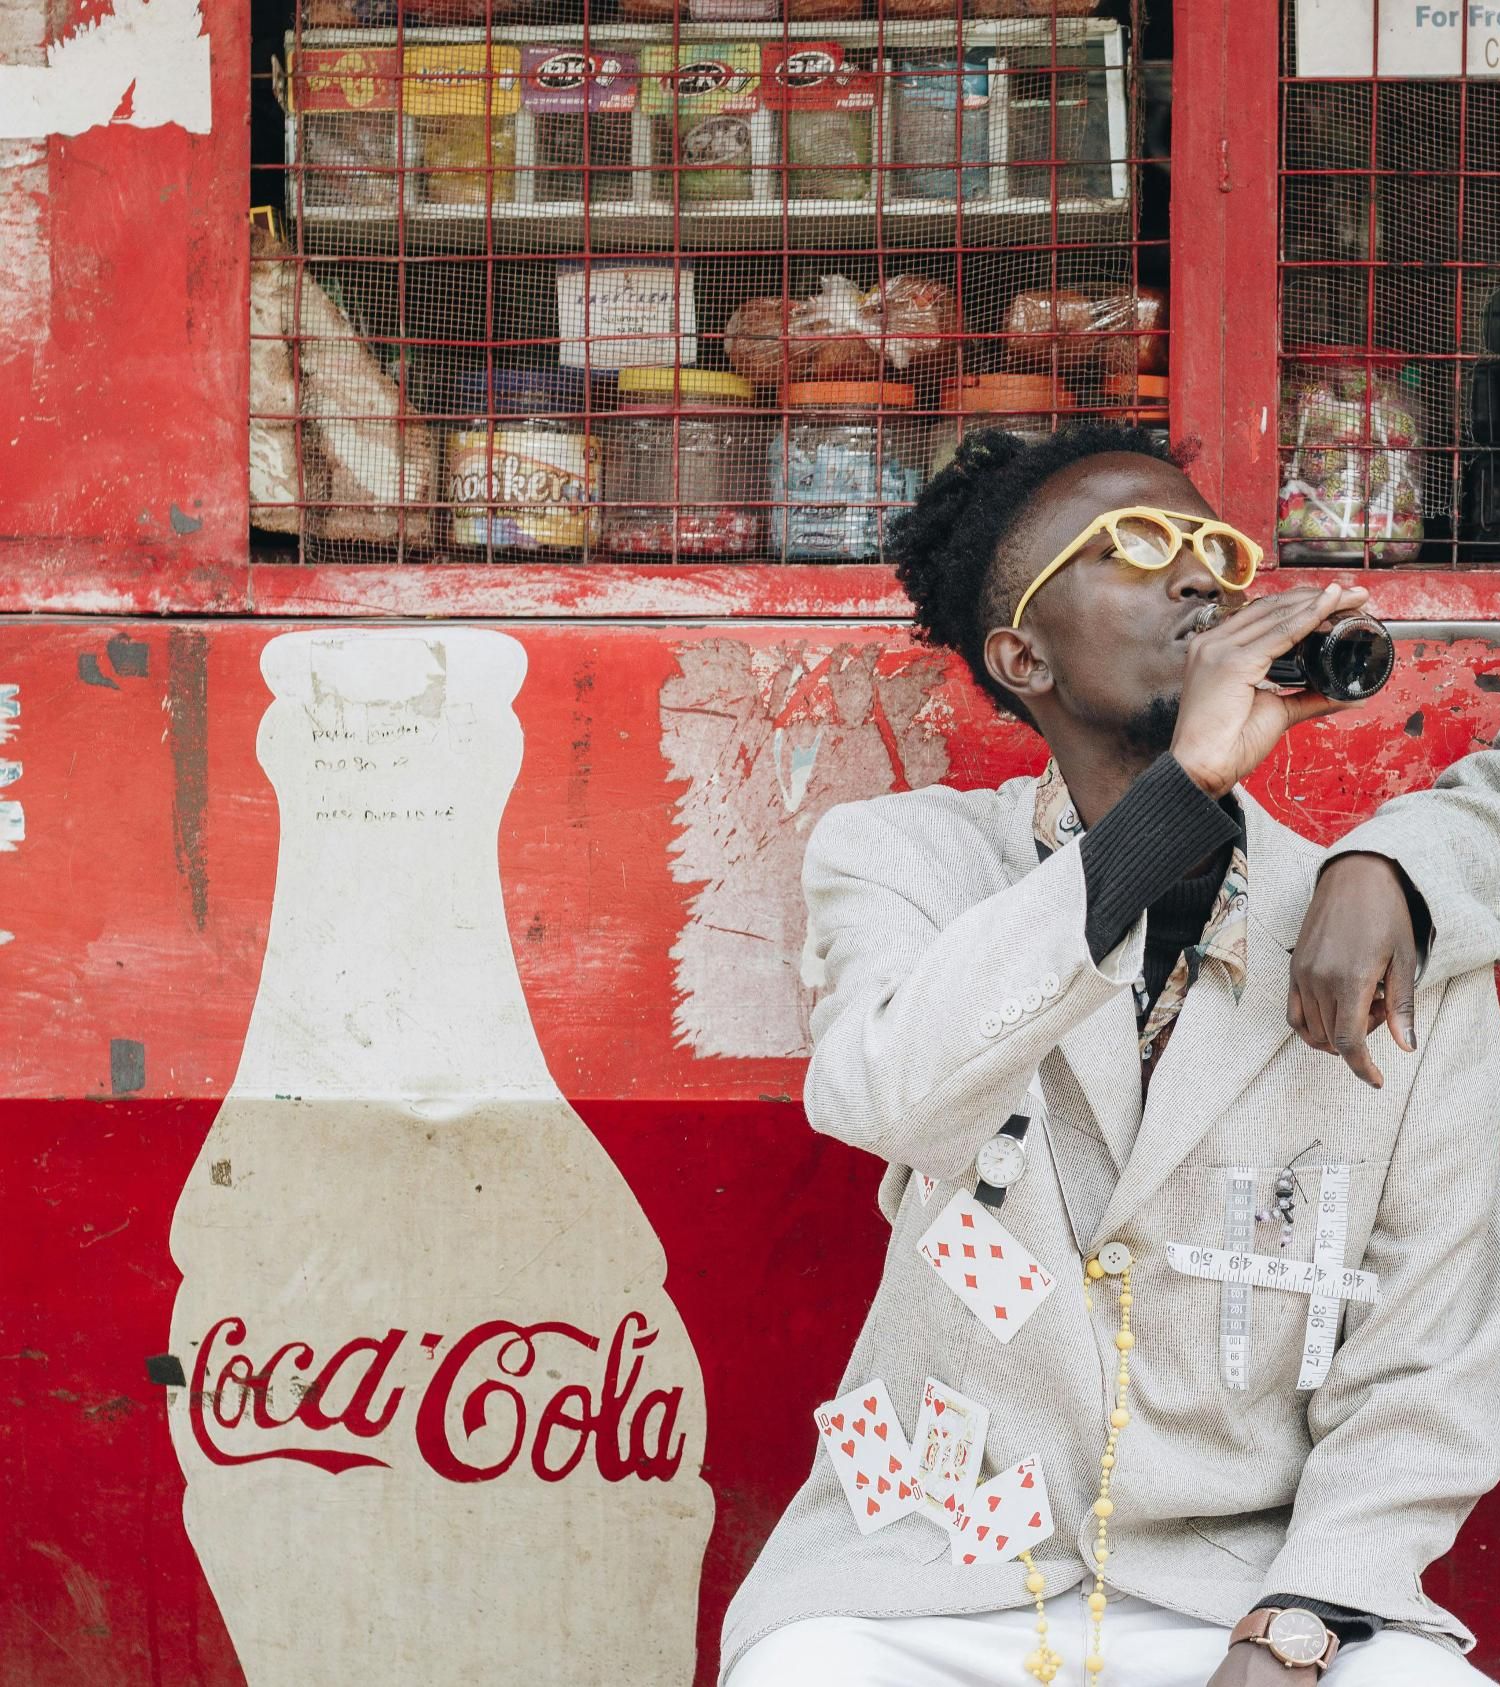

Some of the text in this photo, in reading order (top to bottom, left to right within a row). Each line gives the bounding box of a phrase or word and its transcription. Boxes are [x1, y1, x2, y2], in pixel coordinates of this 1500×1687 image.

[1415, 5, 1459, 27] For
[922, 1245, 933, 1259] 7
[1039, 1272, 1051, 1287] 7
[189, 1311, 687, 1484] Coca-Cola
[926, 1383, 935, 1399] K
[818, 1412, 830, 1429] 10
[912, 1484, 924, 1501] 10
